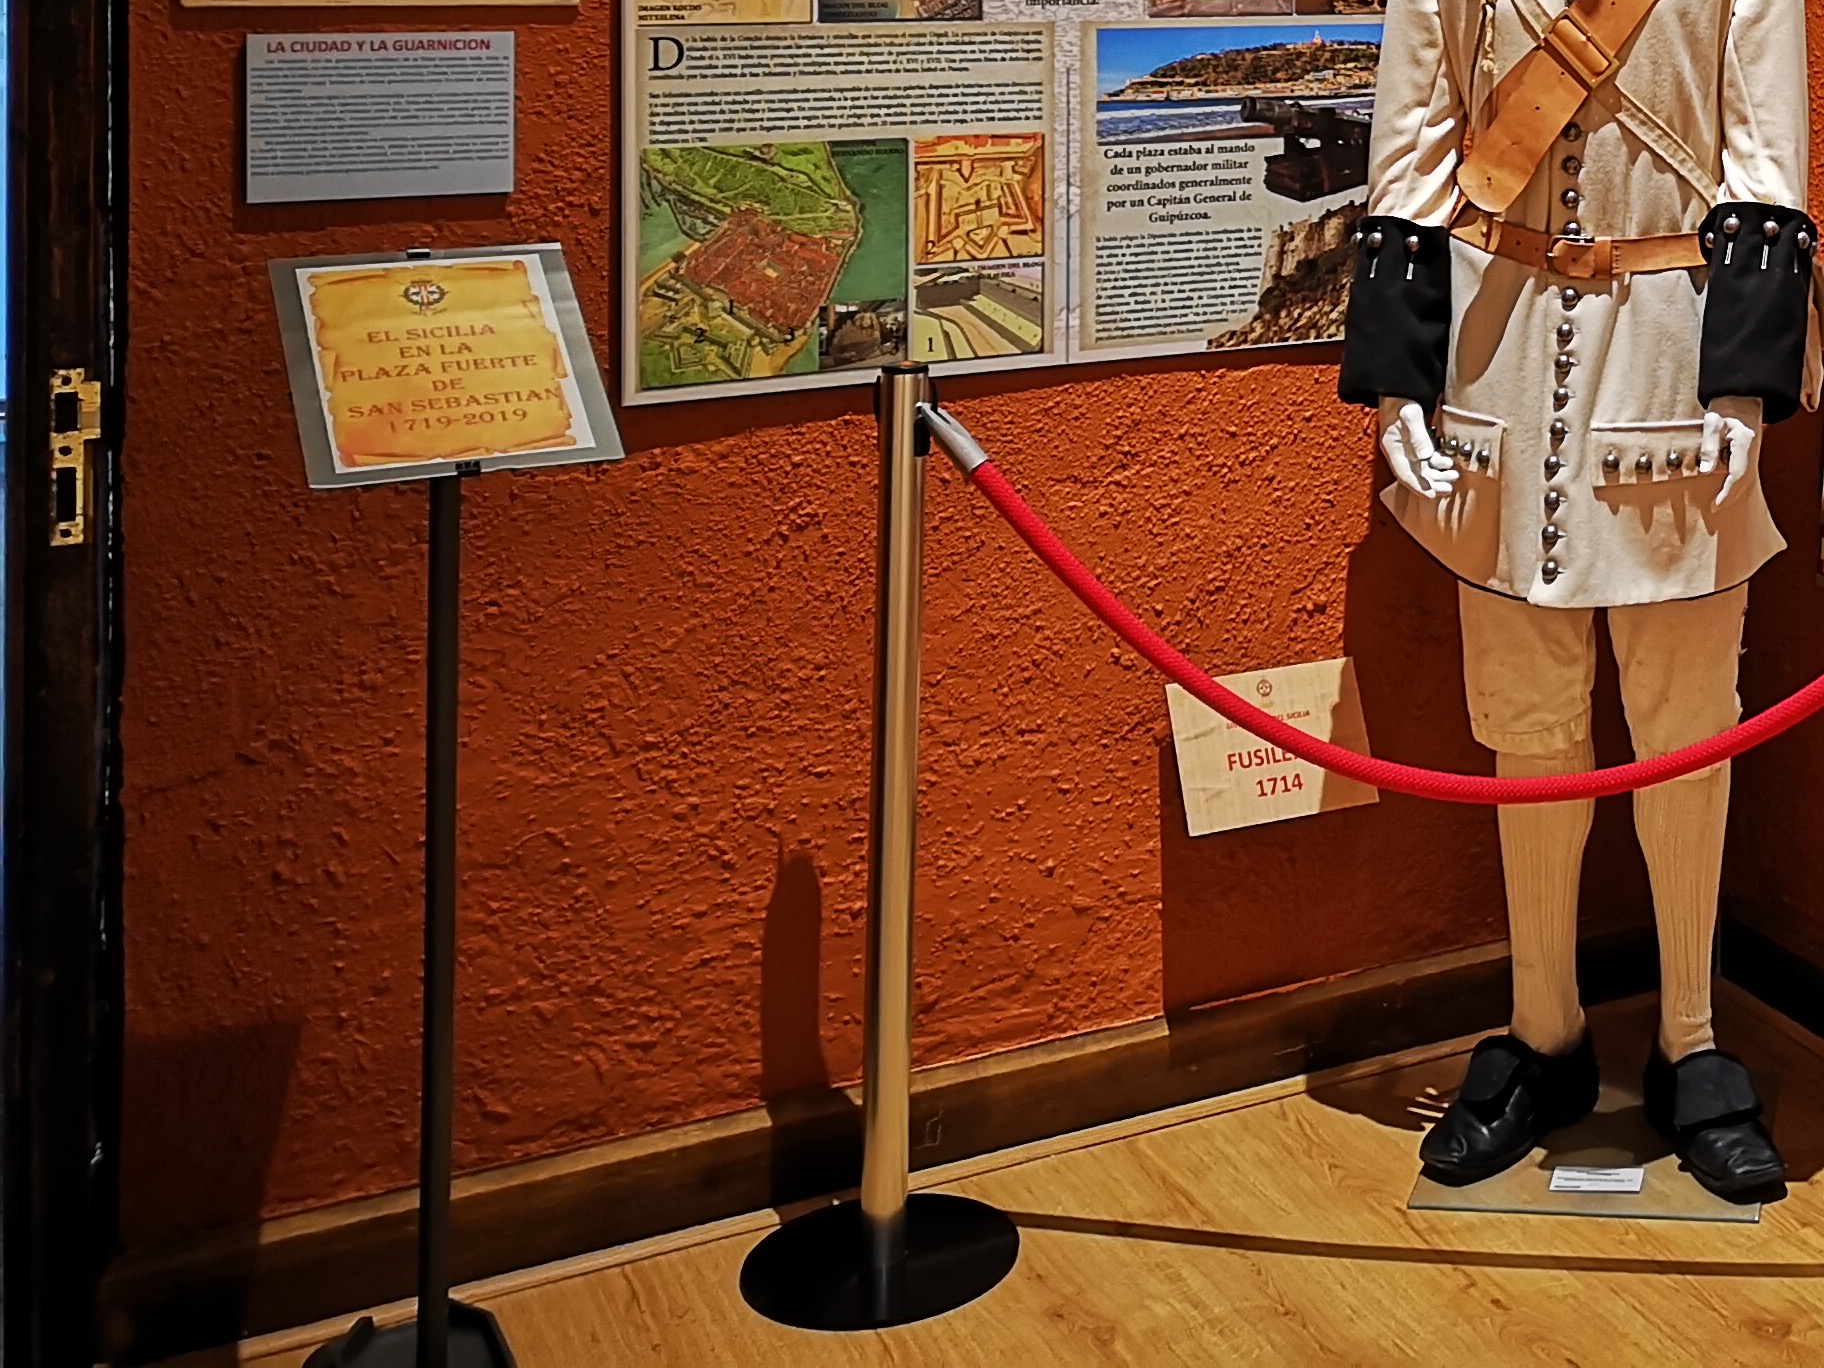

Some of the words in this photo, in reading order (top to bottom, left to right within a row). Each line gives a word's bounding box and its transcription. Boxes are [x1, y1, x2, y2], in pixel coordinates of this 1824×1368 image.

[267, 41, 286, 53] LA
[290, 40, 352, 52] CIUDAD
[356, 40, 366, 51] Y
[369, 40, 389, 51] LA
[392, 39, 493, 51] GUARNICION
[1103, 147, 1133, 159] Cada
[1136, 145, 1165, 160] plaza
[1168, 144, 1202, 155] estaba
[1204, 143, 1214, 154] al
[1217, 142, 1255, 153] mando
[1110, 164, 1124, 175] de
[1126, 166, 1142, 174] un
[1144, 161, 1209, 176] gobernador
[1211, 159, 1249, 169] militar
[1106, 178, 1176, 191] coordinados
[1178, 176, 1252, 191] generalmente
[1106, 200, 1127, 211] por
[1129, 199, 1145, 207] un
[1147, 195, 1191, 208] Capitán
[1193, 191, 1237, 203] General
[1239, 190, 1252, 201] de
[1148, 211, 1212, 224] Guipúzcoa.
[367, 331, 399, 344] EL
[405, 323, 496, 339] SICILIA
[400, 346, 430, 358] EN
[440, 342, 473, 355] LA
[341, 364, 432, 383] PLAZA
[441, 355, 538, 373] FUERTE
[432, 379, 465, 391] DE
[348, 401, 403, 418] SAN
[411, 388, 560, 413] SEBASTIAN
[391, 409, 528, 432] 1719-2019
[1227, 747, 1299, 771] FUSILE
[1256, 773, 1303, 797] 1714
